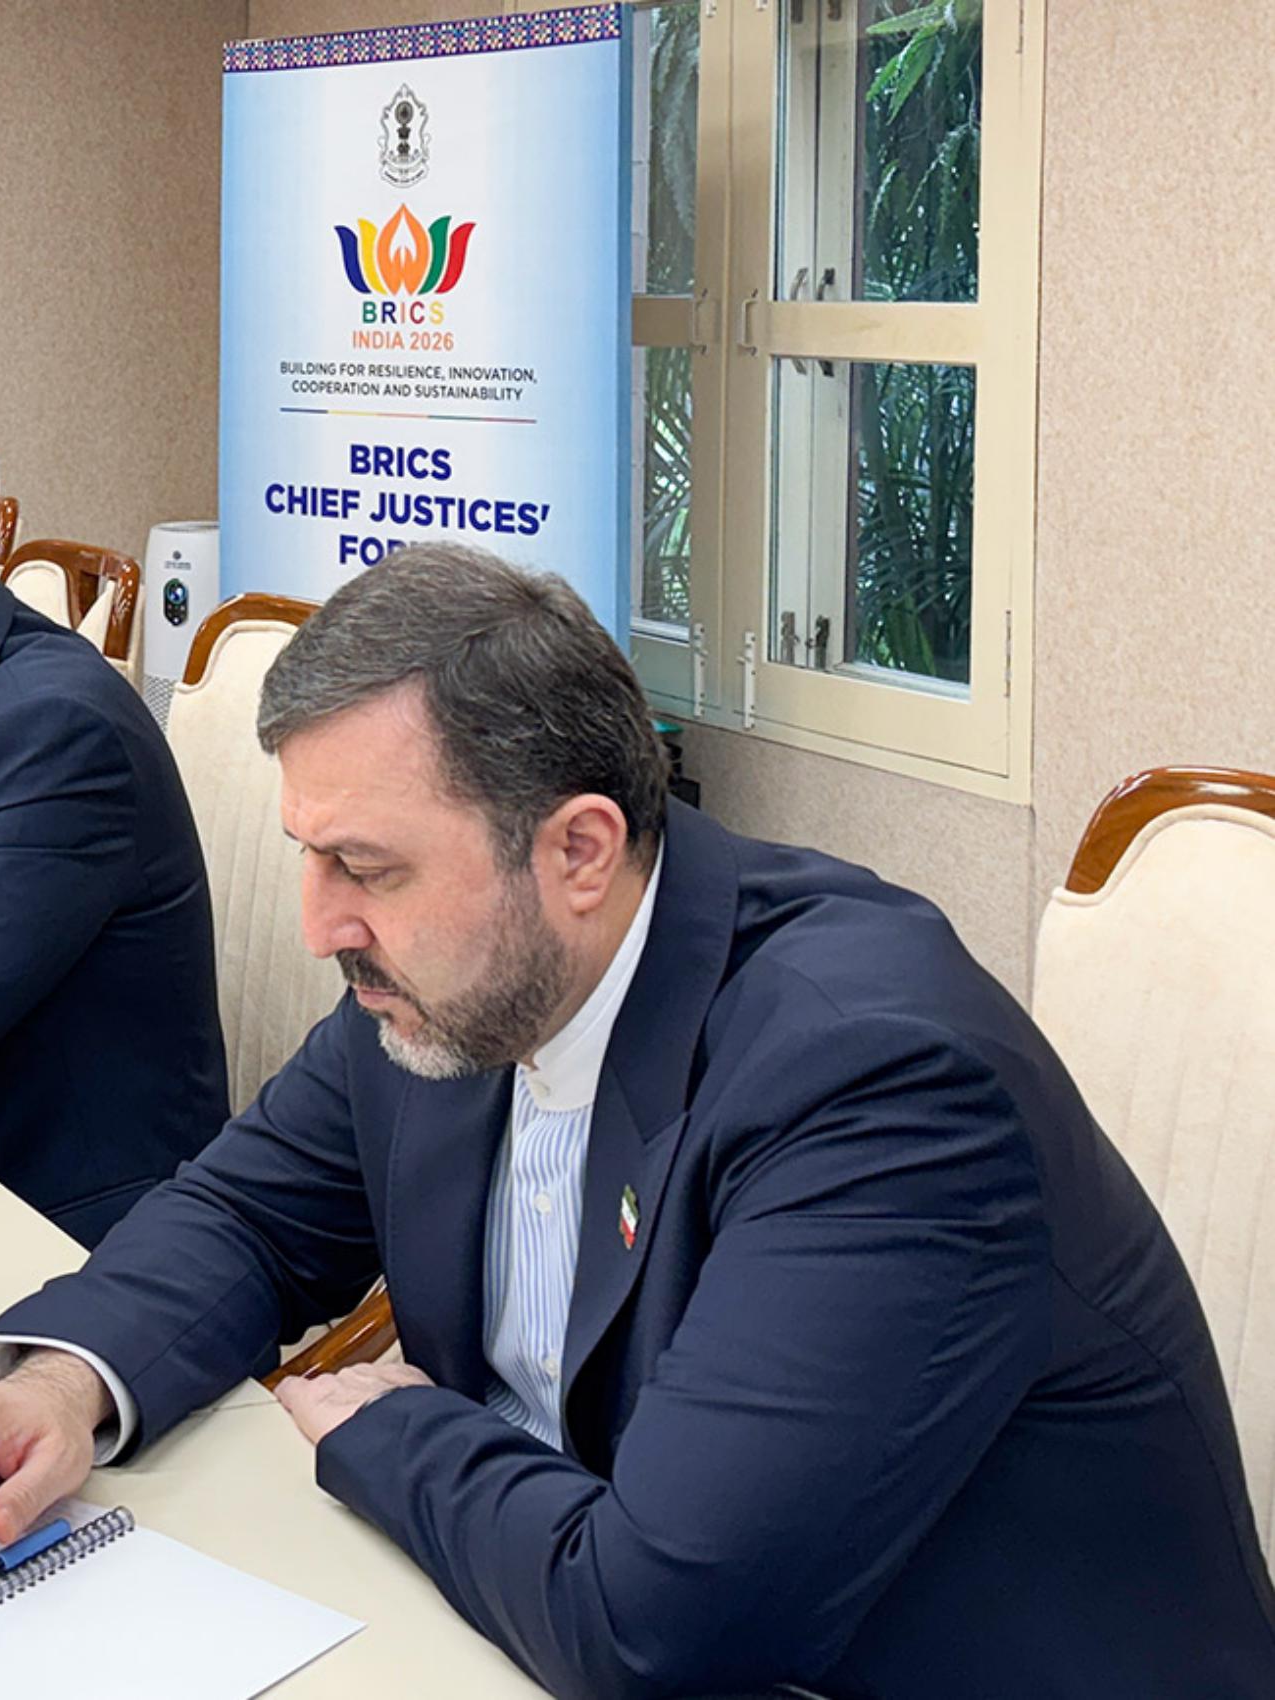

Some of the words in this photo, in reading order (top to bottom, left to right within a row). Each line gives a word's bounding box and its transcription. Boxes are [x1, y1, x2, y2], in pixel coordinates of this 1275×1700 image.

[362, 300, 445, 325] BRICS
[352, 330, 404, 349] INDIA
[409, 332, 454, 351] 2026
[279, 361, 337, 376] BUILDING
[339, 363, 366, 377] FOR
[368, 364, 446, 381] RESILIENCE,
[449, 367, 538, 384] INNOVATION,
[291, 380, 380, 396] COOPERATION
[383, 383, 412, 398] AND
[414, 385, 524, 401] SUSTAINABILITY
[350, 444, 452, 481] BRICS
[265, 484, 360, 519] CHIEF
[370, 493, 550, 535] JUSTICES'
